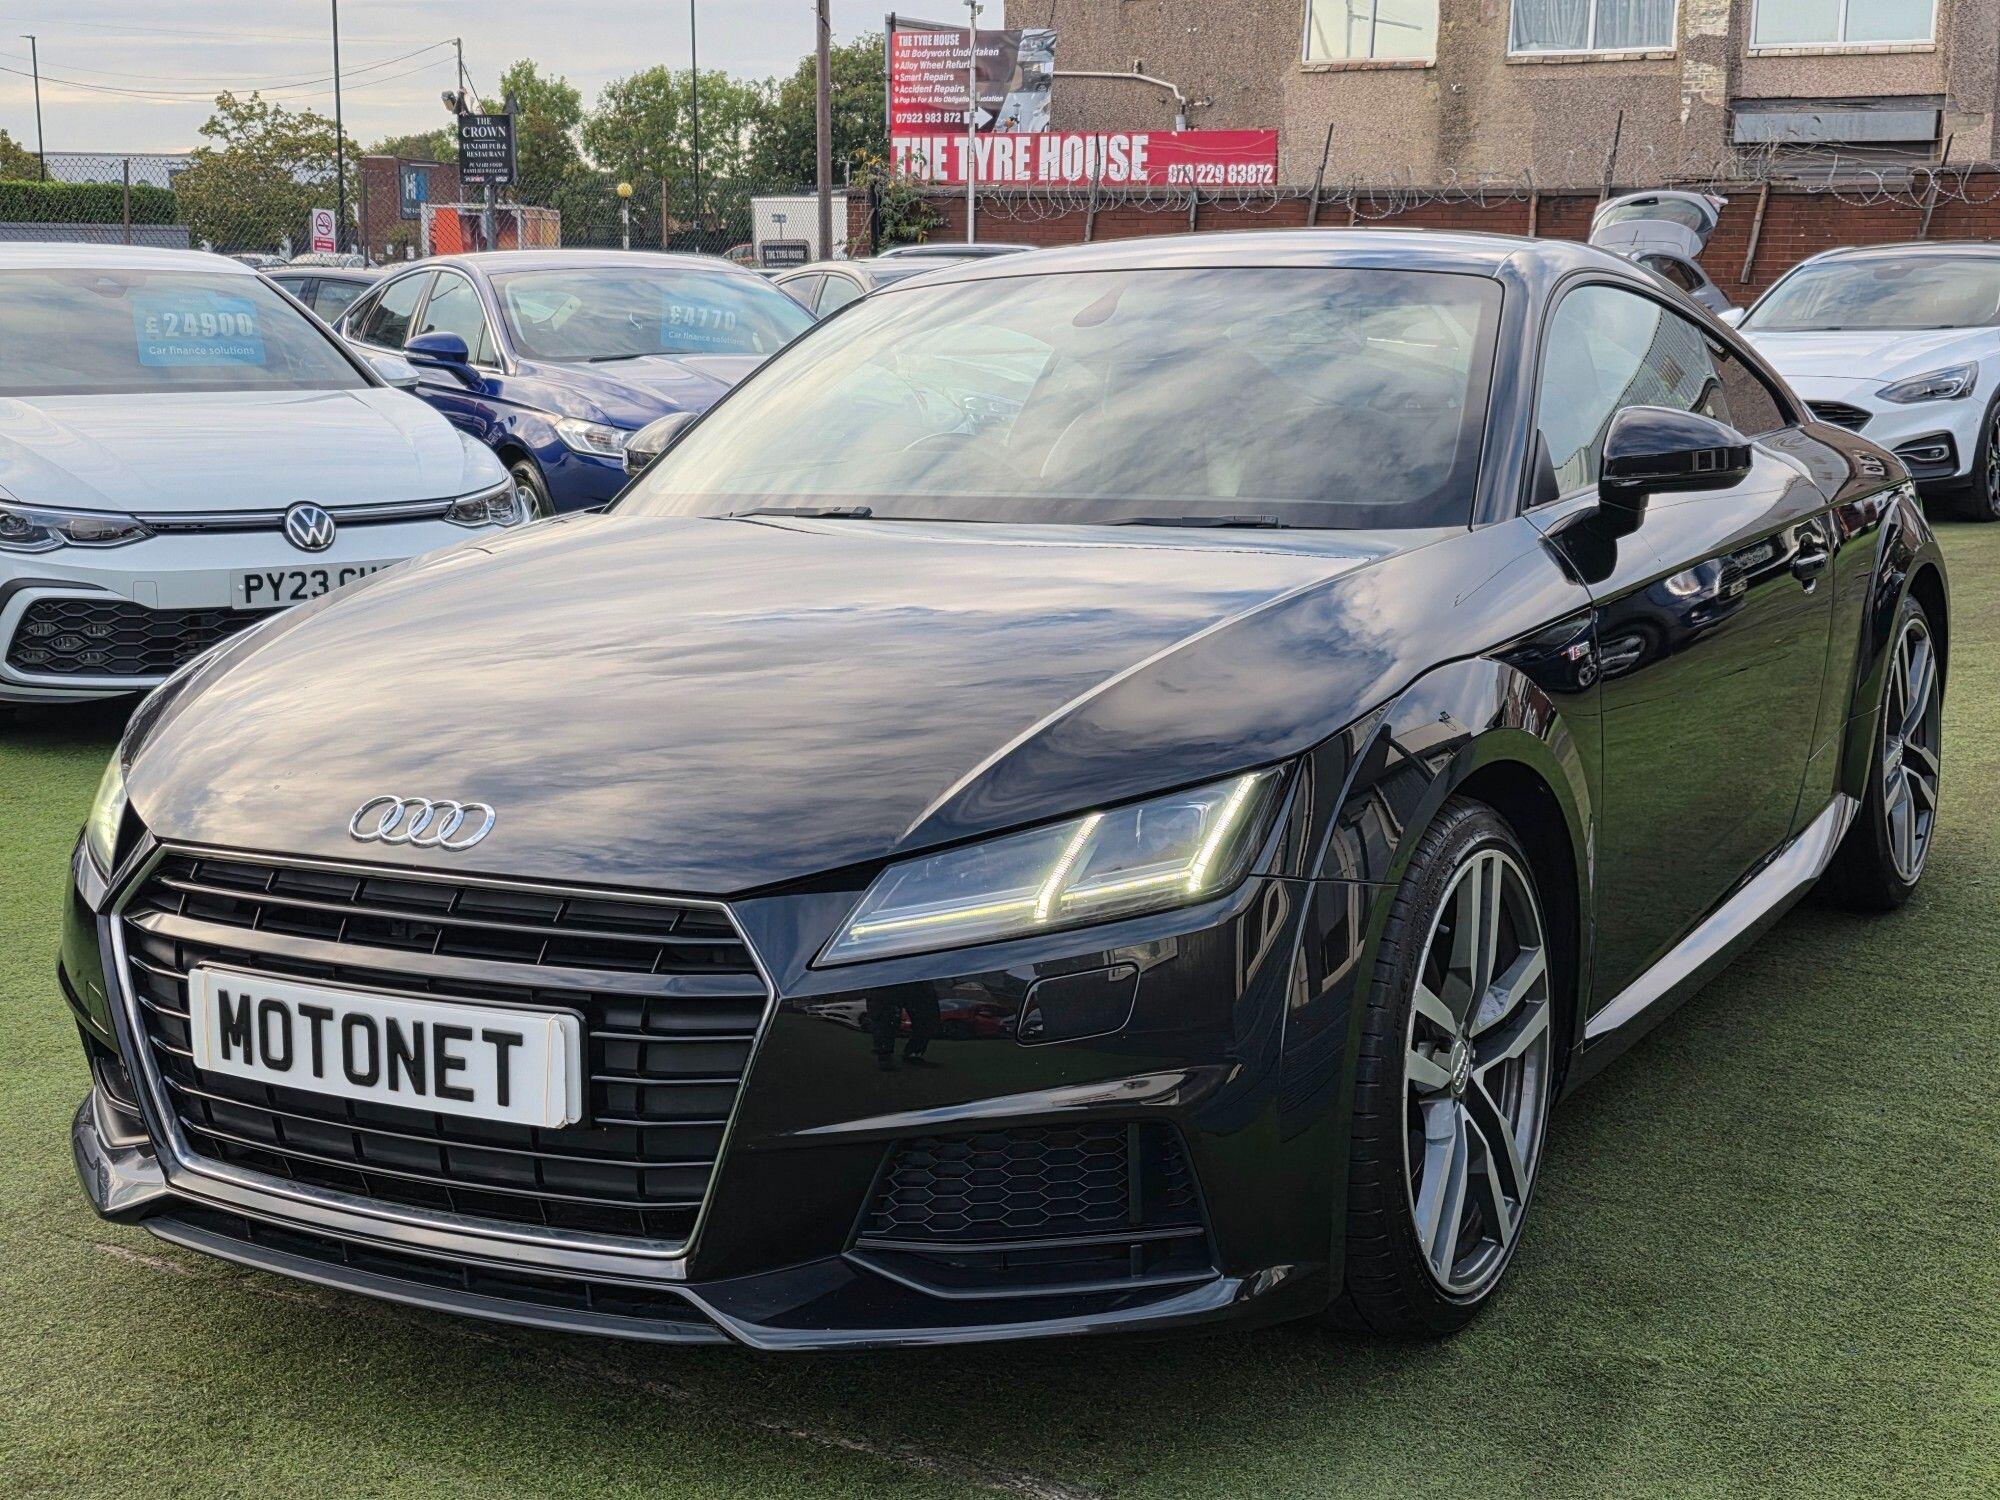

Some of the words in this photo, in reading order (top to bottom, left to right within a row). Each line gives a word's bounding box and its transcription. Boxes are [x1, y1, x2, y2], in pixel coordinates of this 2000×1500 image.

[898, 35, 912, 46] THE
[914, 35, 932, 46] TYRE
[934, 34, 960, 46] HOUSE
[900, 49, 910, 57] All
[911, 48, 951, 59] Bodywork
[953, 47, 999, 57] Undtaken
[900, 61, 918, 71] Alloy
[920, 60, 944, 69] Wheel
[900, 73, 921, 82] Smart
[923, 72, 955, 83] Repairs
[899, 84, 932, 93] Accident
[934, 84, 965, 94] Repairs
[943, 96, 970, 104] Obligatio
[476, 117, 492, 125] THE
[896, 113, 923, 123] 07922
[924, 112, 942, 123] 983
[944, 112, 961, 123] 872
[462, 126, 506, 138] CROWN
[893, 137, 948, 181] THE
[954, 136, 1031, 181] TYRE
[1039, 135, 1149, 182] HOUSE
[1168, 164, 1194, 184] 079
[1195, 164, 1225, 184] 229
[1227, 164, 1274, 184] 83872
[668, 305, 736, 331] £4770
[668, 331, 681, 339] Car
[683, 331, 711, 342] finance
[148, 346, 166, 355] Car
[170, 345, 206, 355] finance
[209, 345, 255, 355] solutions
[244, 569, 330, 604] PY23
[217, 987, 524, 1107] MOTONET
